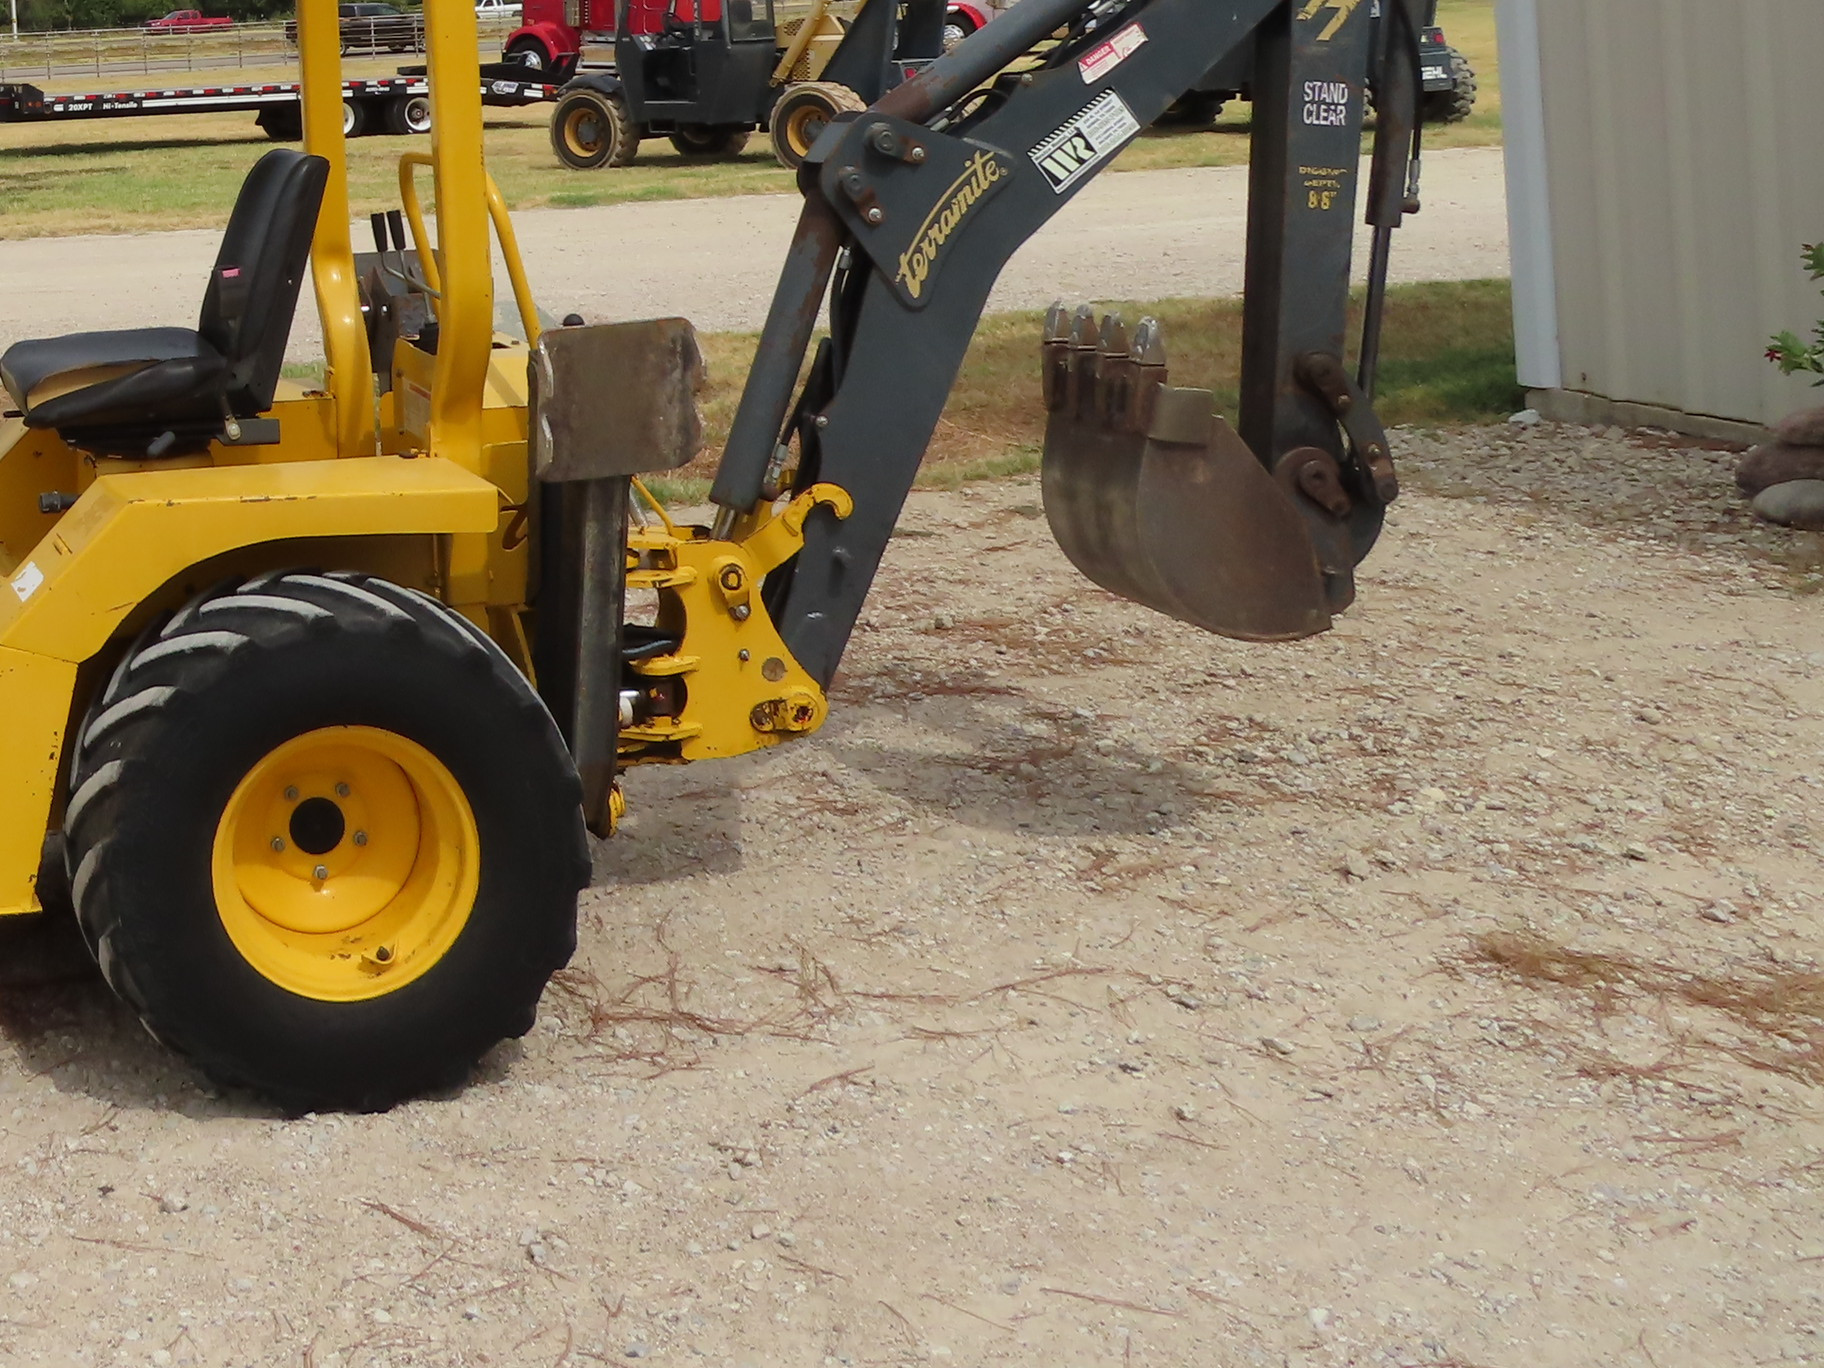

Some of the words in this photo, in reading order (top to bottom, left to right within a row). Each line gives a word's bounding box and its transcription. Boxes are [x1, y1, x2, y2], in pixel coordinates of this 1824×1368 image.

[1085, 45, 1112, 65] DANGER
[1304, 81, 1348, 104] STAND
[1303, 103, 1347, 125] CLEAR
[895, 150, 1000, 298] terramite
